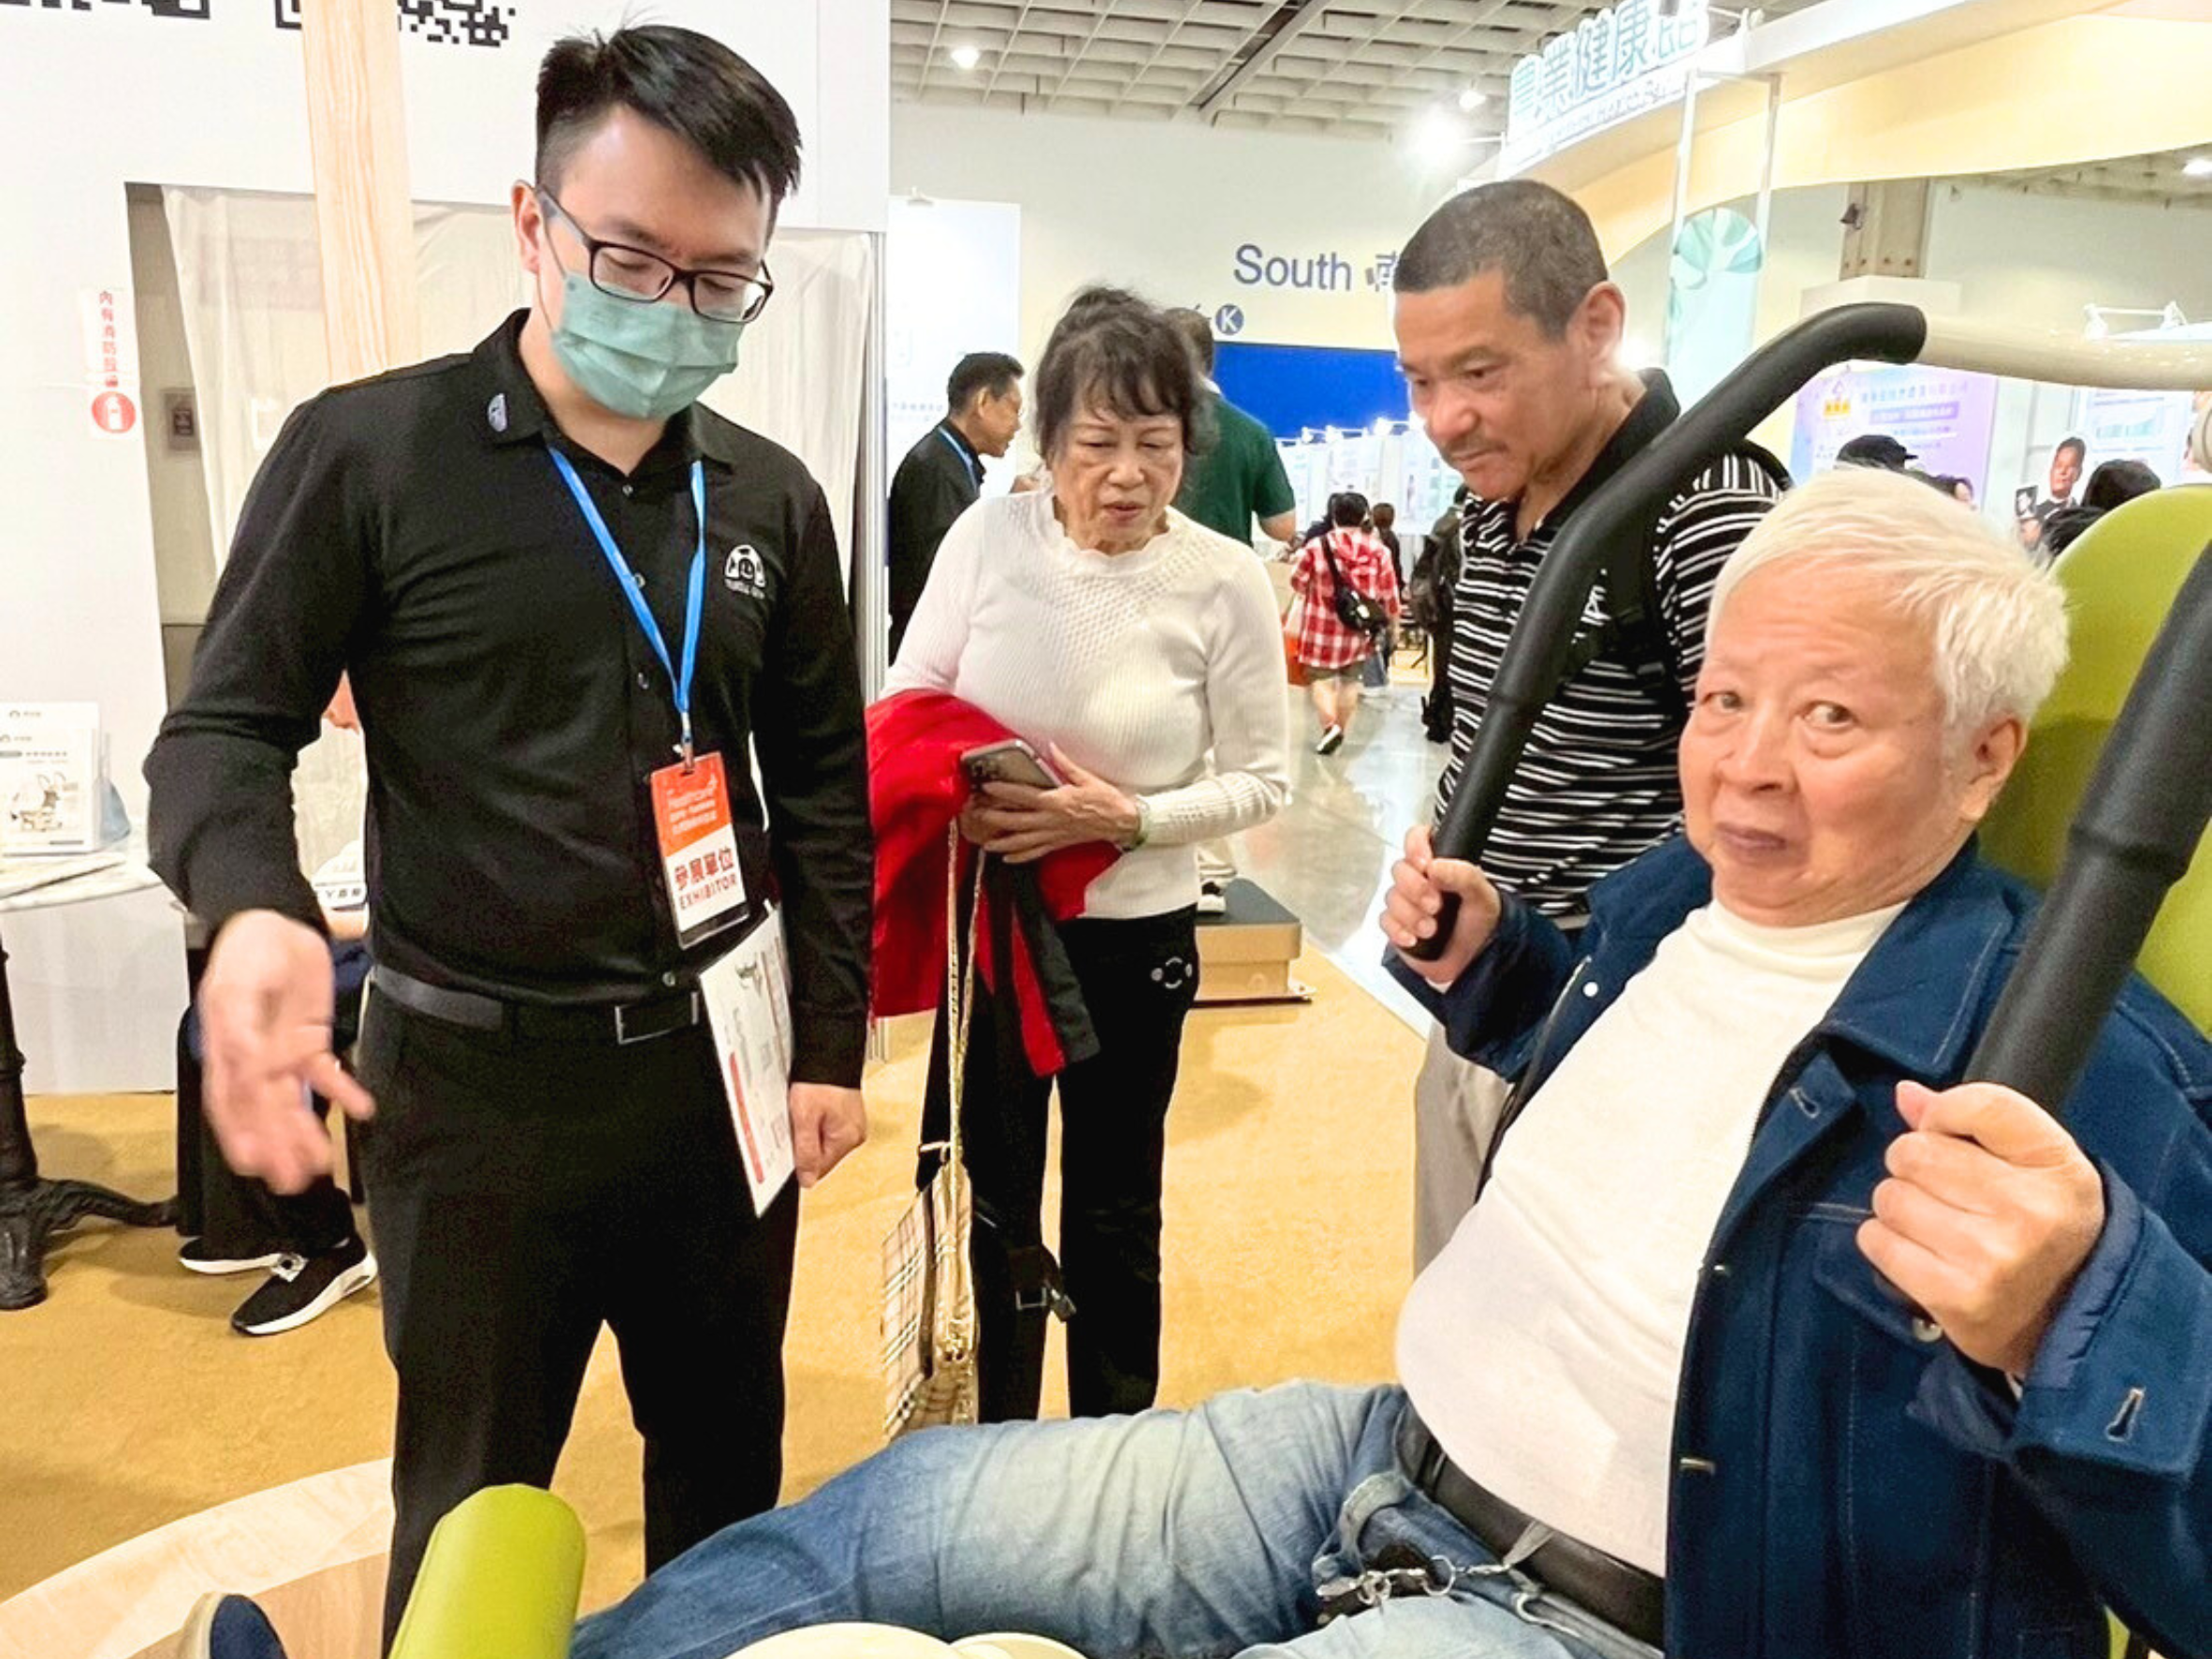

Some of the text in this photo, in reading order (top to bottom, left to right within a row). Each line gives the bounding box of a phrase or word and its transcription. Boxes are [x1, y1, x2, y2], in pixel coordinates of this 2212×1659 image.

[1233, 243, 1352, 291] South
[1219, 306, 1242, 334] K
[678, 871, 736, 910] EXHIBITOR
